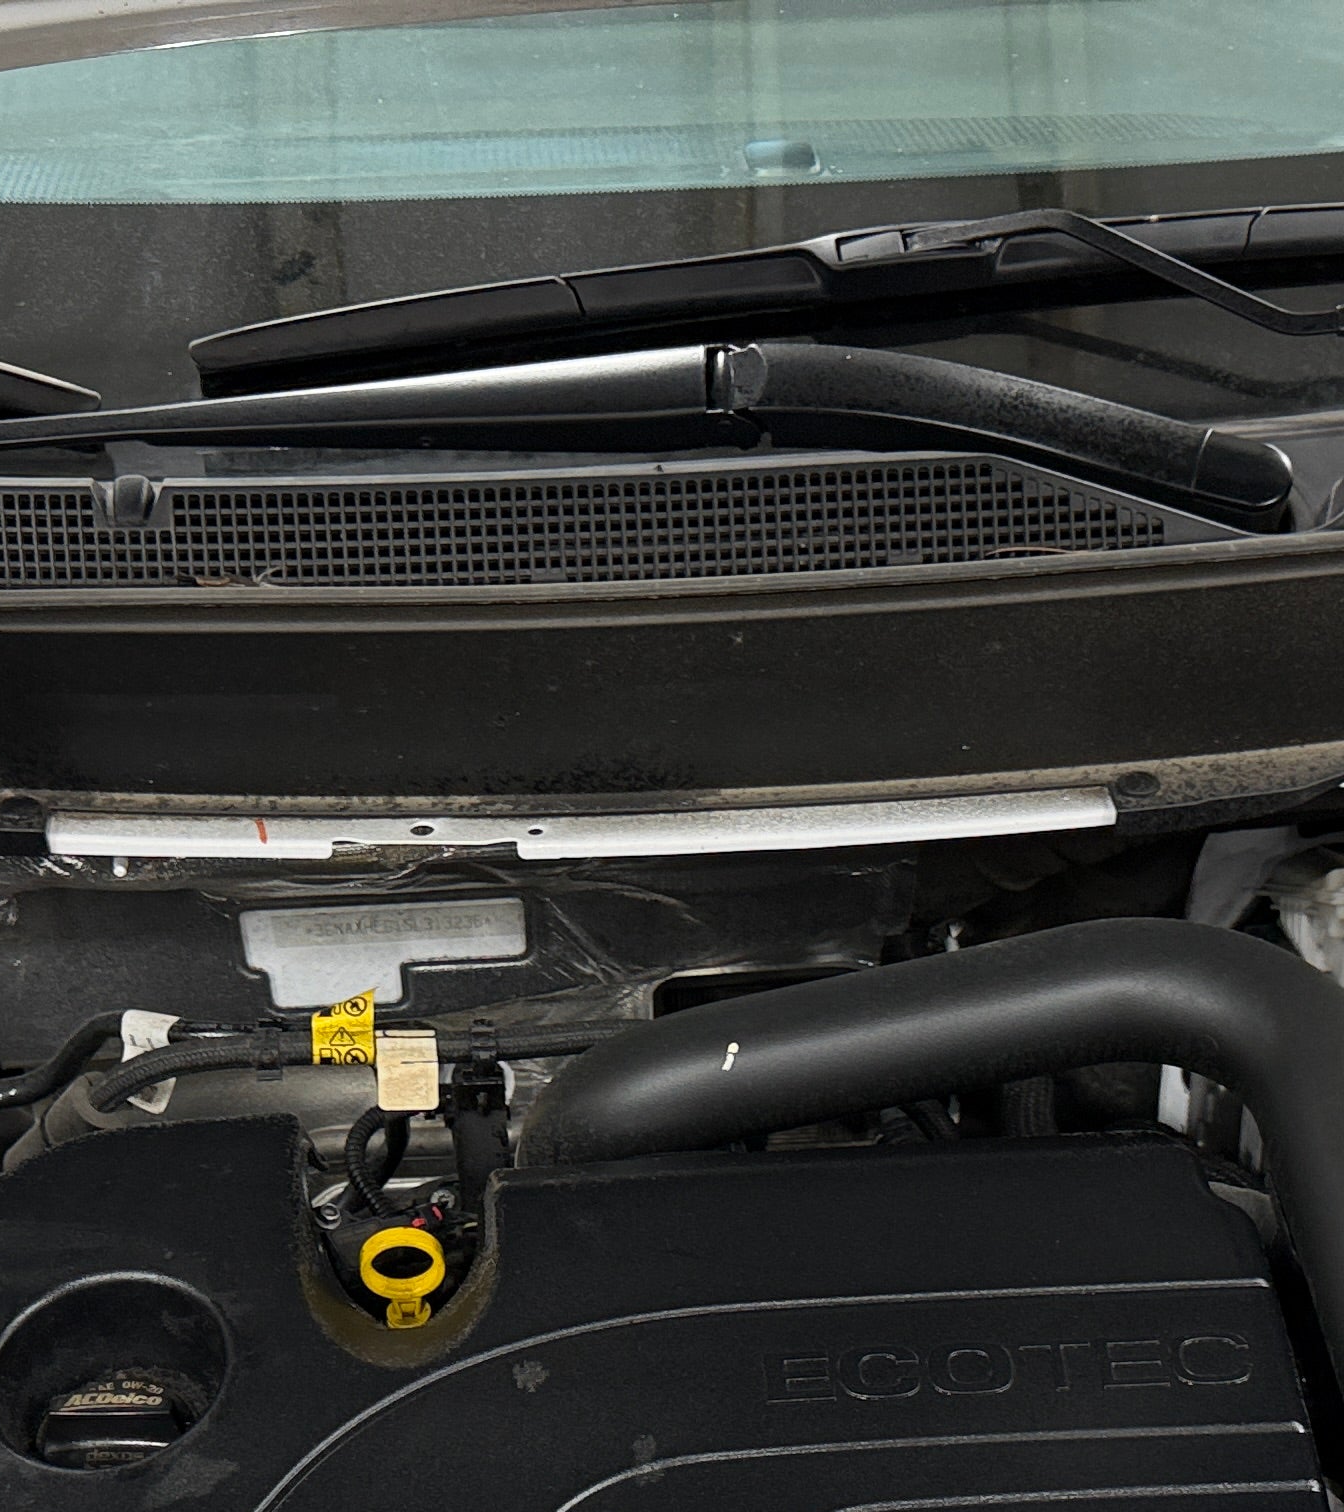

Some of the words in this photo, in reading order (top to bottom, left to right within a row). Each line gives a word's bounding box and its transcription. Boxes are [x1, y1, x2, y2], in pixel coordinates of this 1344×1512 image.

[762, 1332, 1254, 1402] ECOTEC
[122, 1380, 165, 1395] 0W-20
[63, 1393, 164, 1407] ACDelco
